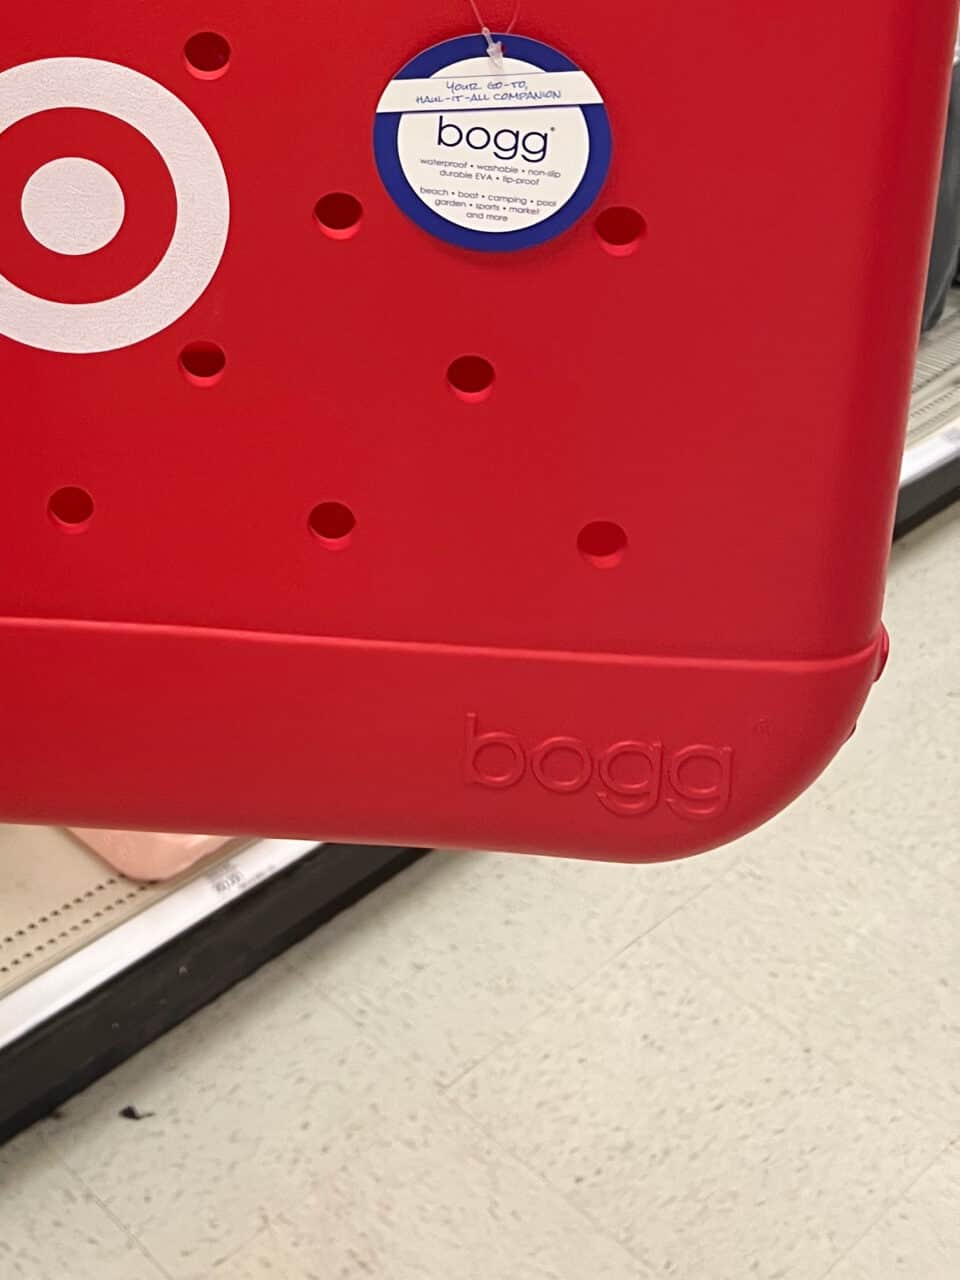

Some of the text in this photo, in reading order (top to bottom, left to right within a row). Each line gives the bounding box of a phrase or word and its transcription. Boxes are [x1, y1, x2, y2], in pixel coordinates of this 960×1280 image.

[446, 81, 482, 94] YOUR
[416, 90, 561, 104] HAUL-IT-ALL COMPANION
[437, 115, 548, 163] bogg
[420, 158, 562, 178] waterproof washable non-slip
[440, 170, 473, 179] durable
[475, 173, 493, 181] EVA
[420, 186, 557, 208] beach boat camping pool
[434, 198, 540, 215] garden sports market
[466, 211, 508, 221] and more
[464, 711, 736, 820] bogg
